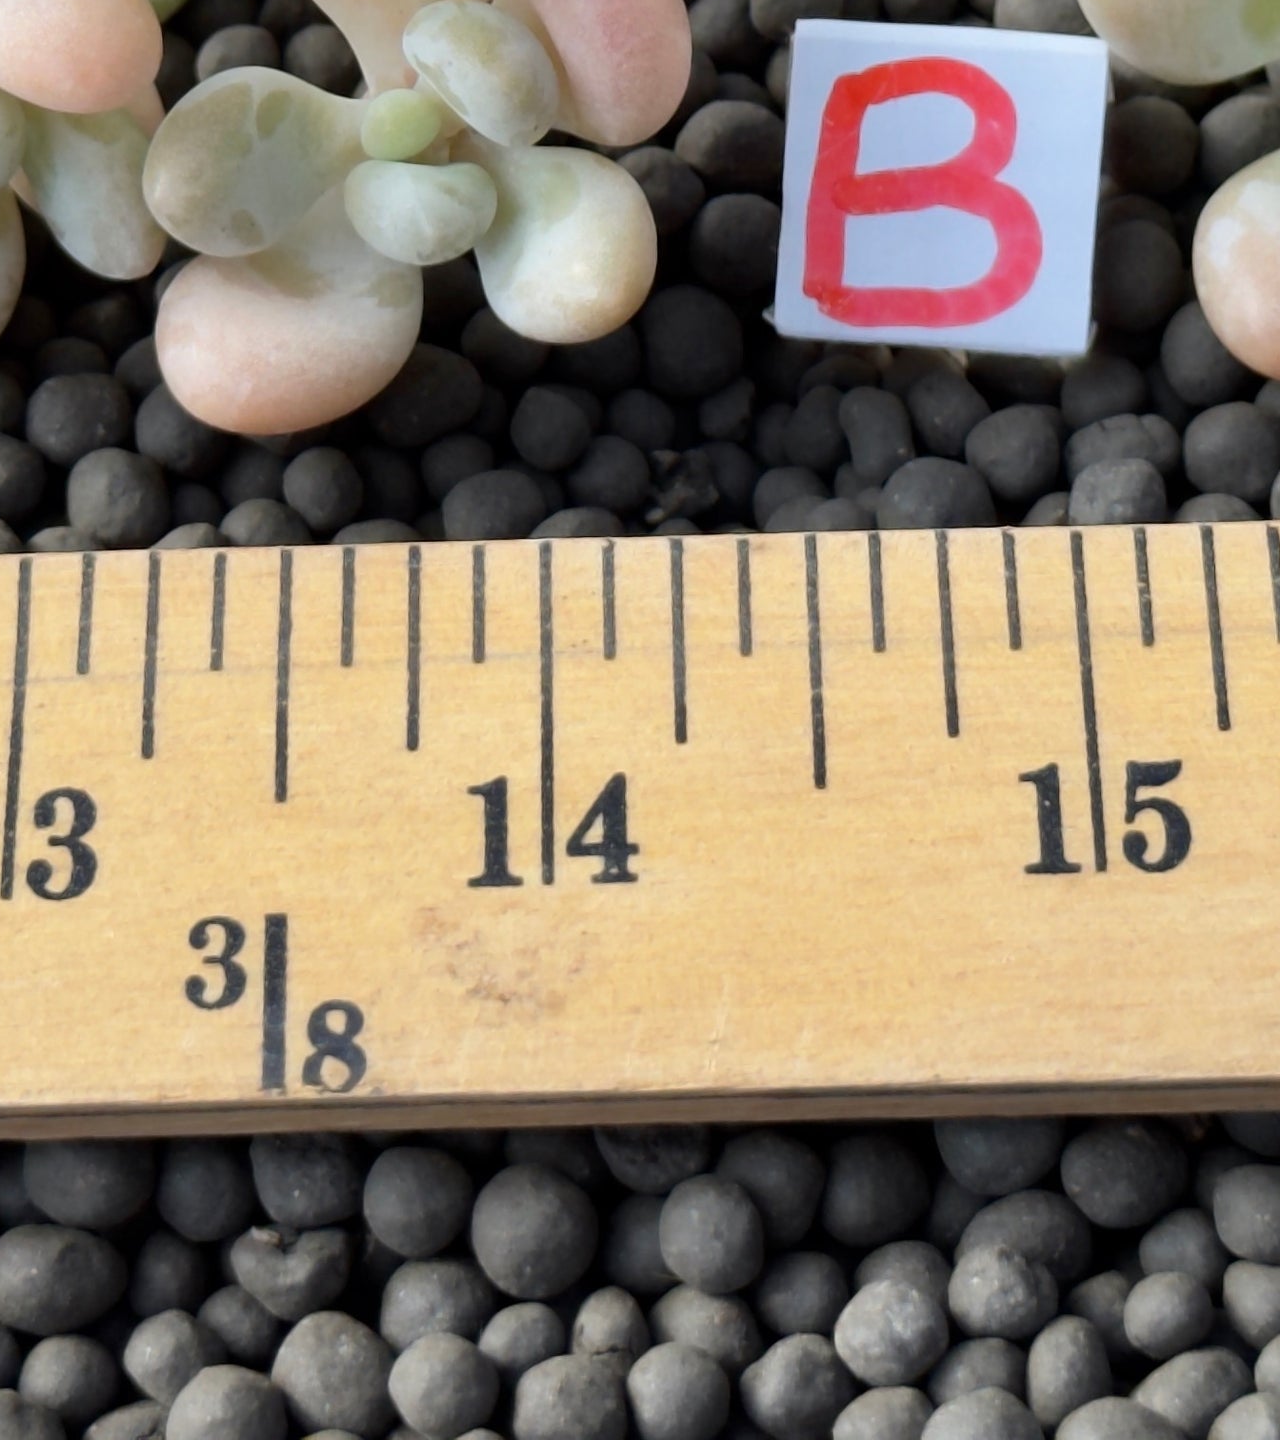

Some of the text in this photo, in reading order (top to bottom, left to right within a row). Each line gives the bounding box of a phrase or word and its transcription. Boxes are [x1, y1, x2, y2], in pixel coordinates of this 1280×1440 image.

[803, 55, 1043, 329] B
[466, 771, 641, 888] 14
[1018, 759, 1193, 875] 15
